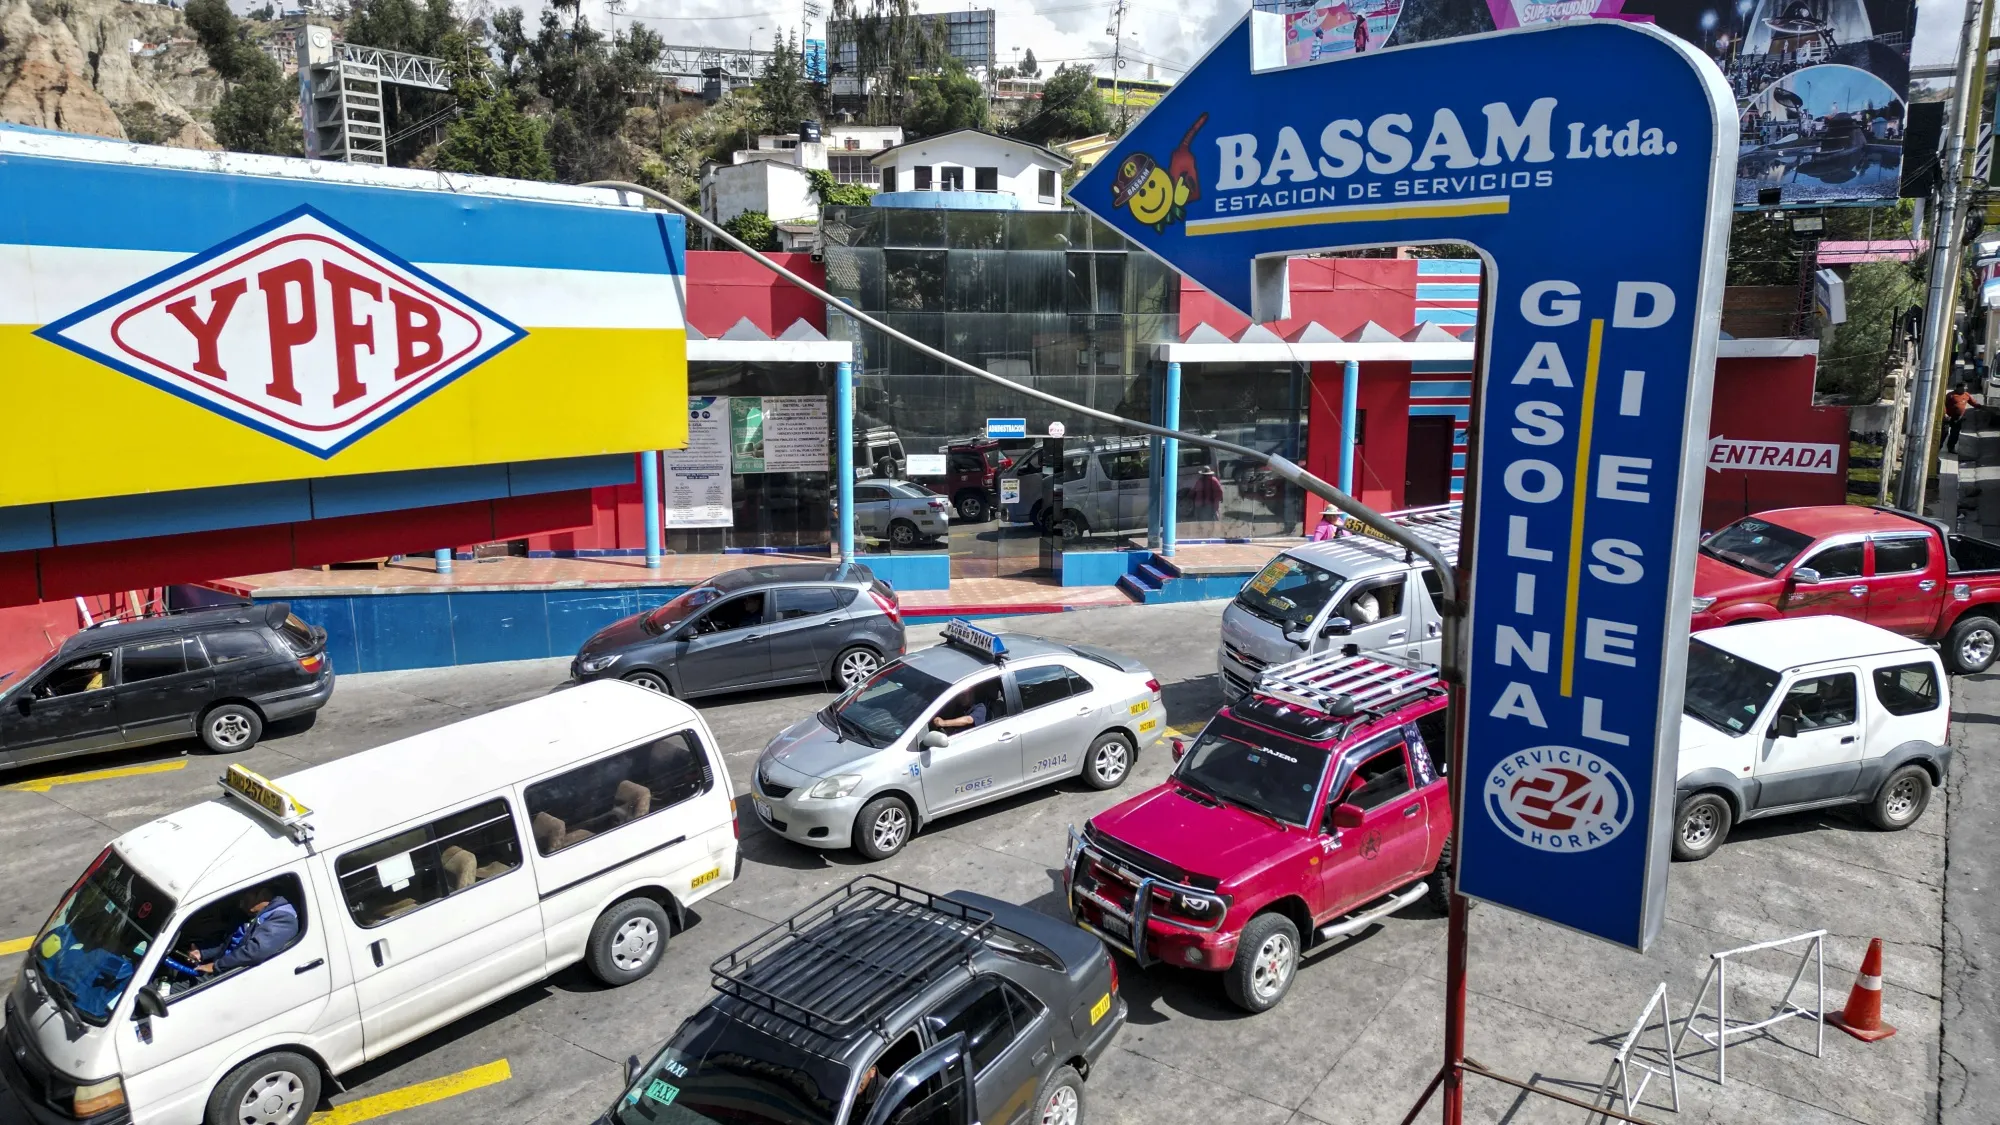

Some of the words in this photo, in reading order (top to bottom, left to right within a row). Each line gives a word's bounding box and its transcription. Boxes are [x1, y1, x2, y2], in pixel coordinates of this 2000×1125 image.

[1523, 0, 1595, 22] SUPERCIUDAD
[1215, 97, 1558, 191] BASSAM
[1566, 119, 1678, 159] Ltda.
[1126, 168, 1150, 196] BASSAM
[1215, 186, 1335, 212] ESTACION
[1348, 182, 1381, 199] DE
[1394, 170, 1553, 196] SERVICIOS
[166, 258, 444, 408] YPFB
[1709, 445, 1832, 468] ENTRADA
[1489, 280, 1581, 729] GASOLINA
[1581, 281, 1676, 746] DIESEL
[947, 624, 970, 639] FLORES
[970, 630, 993, 649] 791414
[1032, 753, 1067, 773] 2791414
[1263, 747, 1298, 763] PAJERO
[909, 764, 919, 776] 15
[1492, 749, 1601, 789] SERVICIO
[245, 779, 264, 803] 257
[954, 777, 993, 795] FLORES
[1509, 768, 1604, 830] 24
[1531, 821, 1615, 848] HORAS
[664, 1059, 688, 1078] TAXI
[651, 1082, 677, 1102] TAXI
